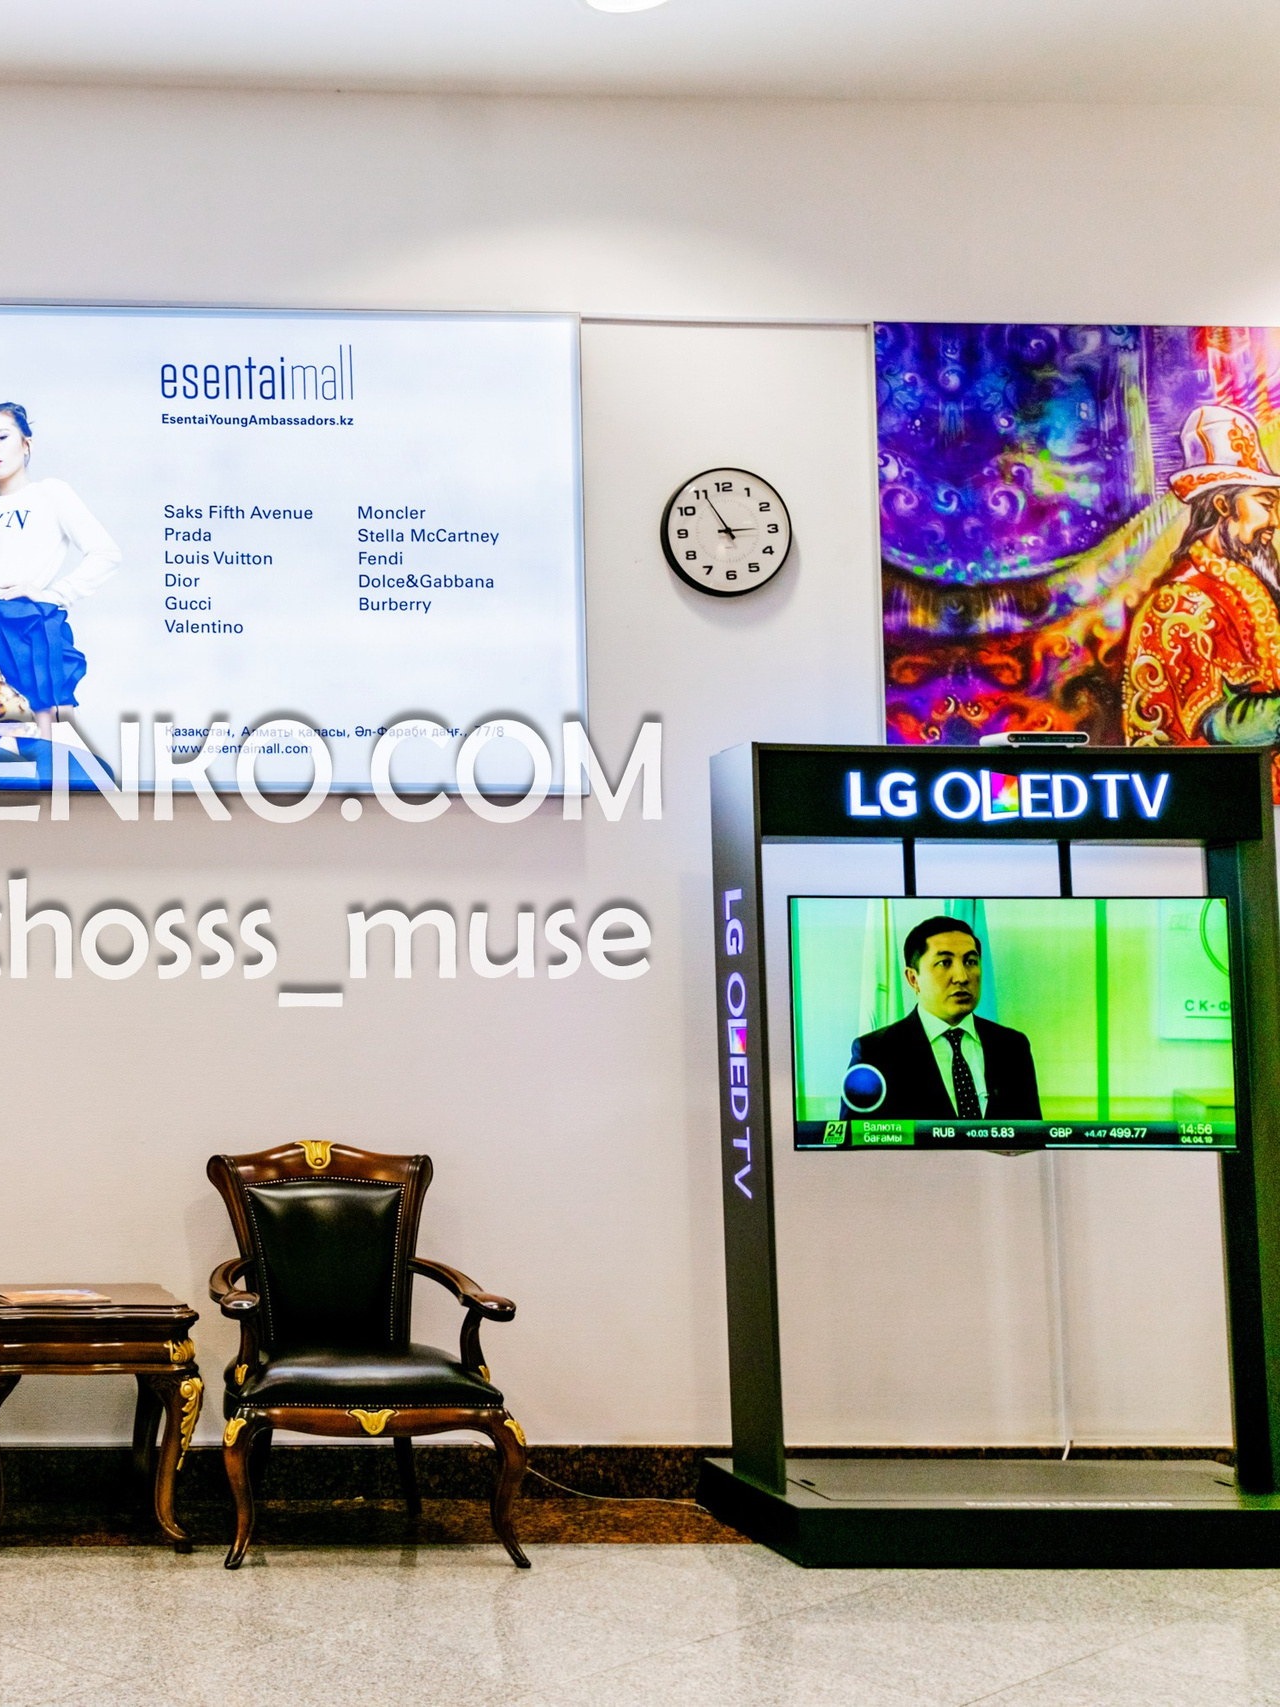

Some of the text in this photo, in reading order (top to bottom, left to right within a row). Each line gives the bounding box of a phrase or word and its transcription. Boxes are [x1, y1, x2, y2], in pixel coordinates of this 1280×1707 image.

[160, 344, 354, 401] esentaimall
[161, 413, 355, 428] EsentaiYoungAmbassadors.kz
[714, 482, 733, 492] 12
[744, 487, 751, 497] 1
[694, 489, 708, 500] 11
[164, 504, 314, 520] Saks Fifth Avenue
[677, 506, 696, 516] 10
[758, 501, 771, 512] 2
[357, 506, 426, 520] Moncler
[164, 527, 212, 542] Prada
[677, 529, 689, 539] 9
[767, 523, 779, 534] 3
[357, 528, 500, 546] Stella McCartney
[685, 550, 697, 560] 8
[762, 545, 775, 555] 4
[165, 550, 273, 565] Louis Vuitton
[358, 551, 403, 566] Fendi
[702, 565, 713, 575] 7
[748, 562, 760, 573] 5
[165, 573, 200, 588] Dior
[358, 573, 495, 589] Dolce&Gabbana
[725, 570, 737, 580] 6
[165, 596, 212, 610] Gucci
[359, 597, 432, 614] Burberry
[164, 619, 244, 634] Valentino
[474, 726, 505, 738] 77/8
[165, 743, 313, 754] www.esentaimall.com
[848, 768, 1170, 822] LG OLED TV
[724, 887, 754, 1200] LG OLED TV
[827, 1123, 844, 1137] 24
[863, 1121, 902, 1132] Валюта
[932, 1127, 1015, 1138] RUB +0.03 5.83
[1180, 1123, 1213, 1135] 14:56
[863, 1132, 903, 1143] бағамы
[1049, 1127, 1148, 1139] GBP +4.47 499.77
[1180, 1136, 1213, 1144] 04.04.19
